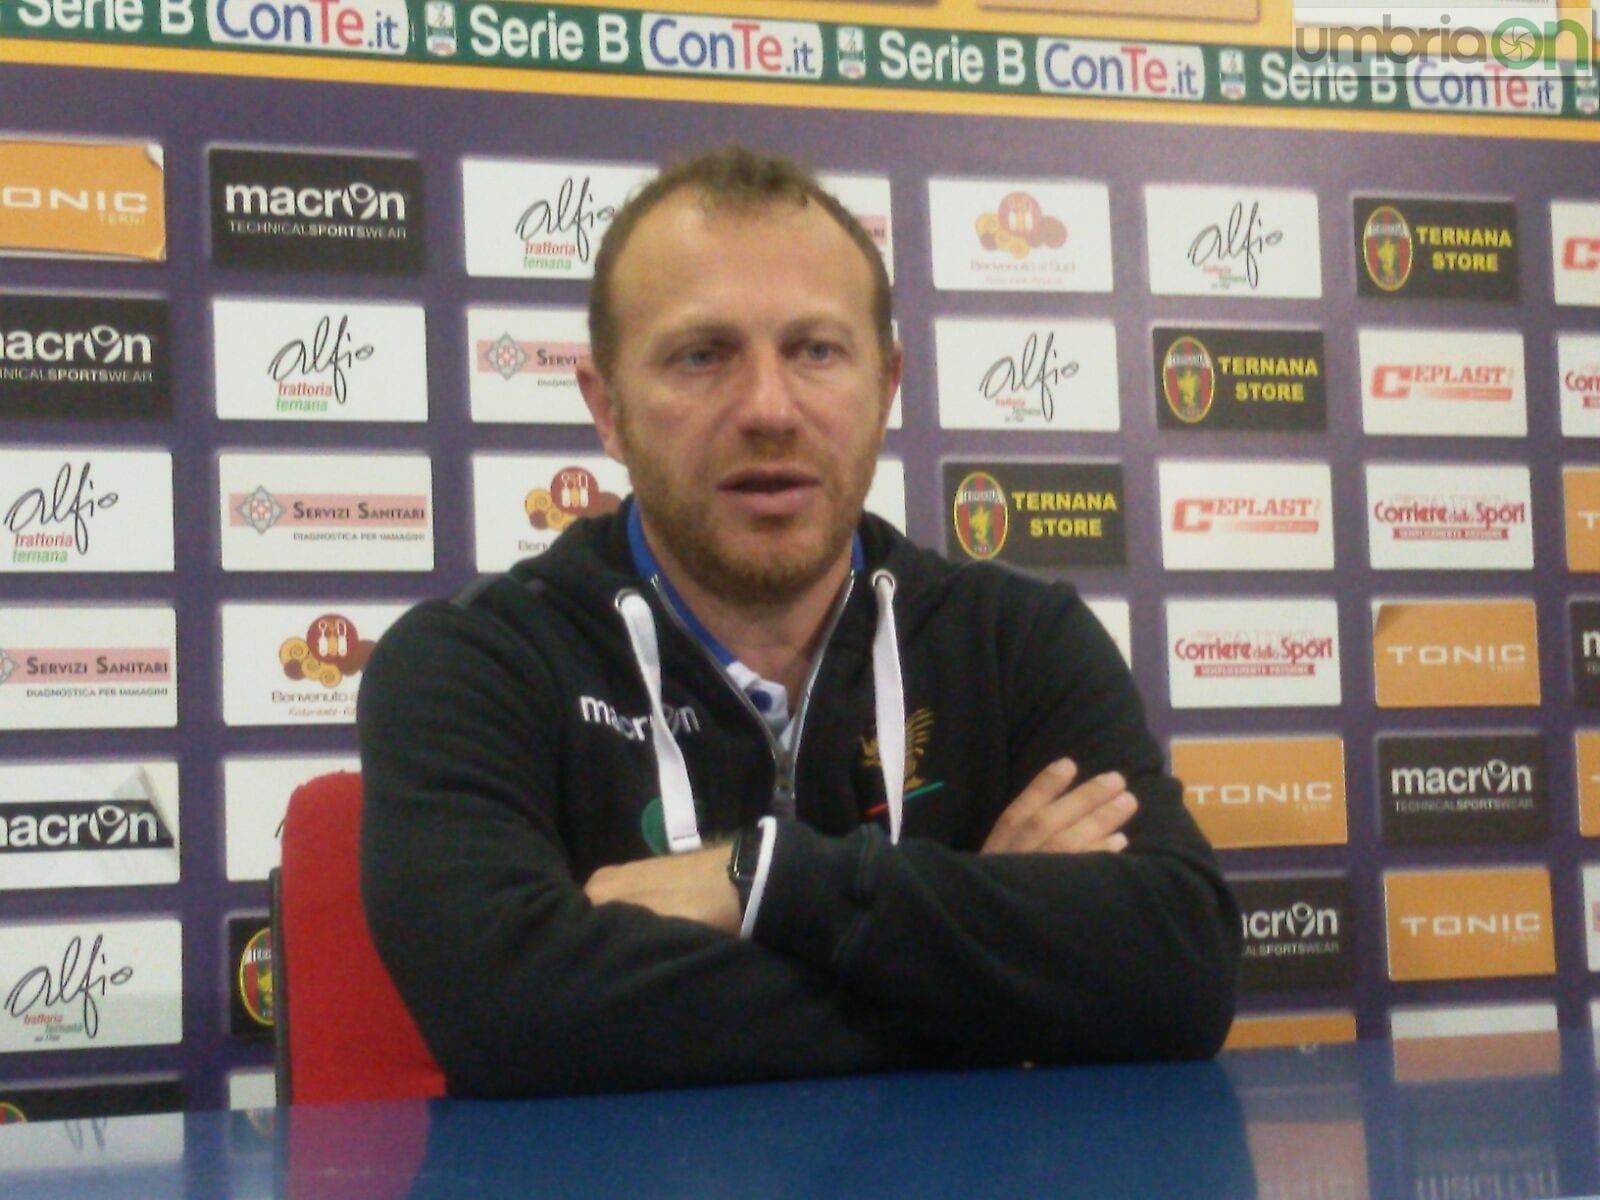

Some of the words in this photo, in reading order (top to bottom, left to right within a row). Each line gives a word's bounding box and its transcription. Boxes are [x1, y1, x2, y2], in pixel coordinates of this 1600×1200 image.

[161, 0, 194, 34] B
[217, 0, 400, 49] ConTe.it
[470, 5, 583, 60] Serie
[599, 14, 629, 63] B
[649, 18, 815, 73] ConTe.it
[879, 30, 984, 83] Serie
[997, 38, 1026, 85] B
[1043, 43, 1198, 95] ConTe.it
[1261, 52, 1358, 102] Serie
[1370, 57, 1397, 103] B
[1411, 62, 1557, 109] ConTe.it
[2, 186, 148, 214] ONIC
[226, 182, 406, 221] macron
[1187, 200, 1284, 289] alfio
[1416, 226, 1512, 247] TERNANA
[1432, 253, 1498, 272] STORE
[267, 314, 374, 405] alfio
[537, 349, 577, 367] SERVI
[1217, 356, 1318, 377] TERNANA
[979, 330, 1080, 423] alfio
[1235, 382, 1304, 402] STORE
[3, 461, 119, 556] alfio
[1012, 492, 1117, 511] TERNANA
[1374, 501, 1447, 523] Corriere
[1476, 502, 1526, 529] Sport
[15, 532, 73, 548] trattoria
[1030, 518, 1103, 537] STORE
[1174, 637, 1251, 660] Corriere
[1281, 636, 1333, 664] Sport
[1387, 643, 1526, 665] TONIC
[1186, 781, 1333, 806] TONIC
[1391, 758, 1533, 795] macron
[1401, 912, 1541, 937] TONIC
[4, 933, 133, 1039] alfio
